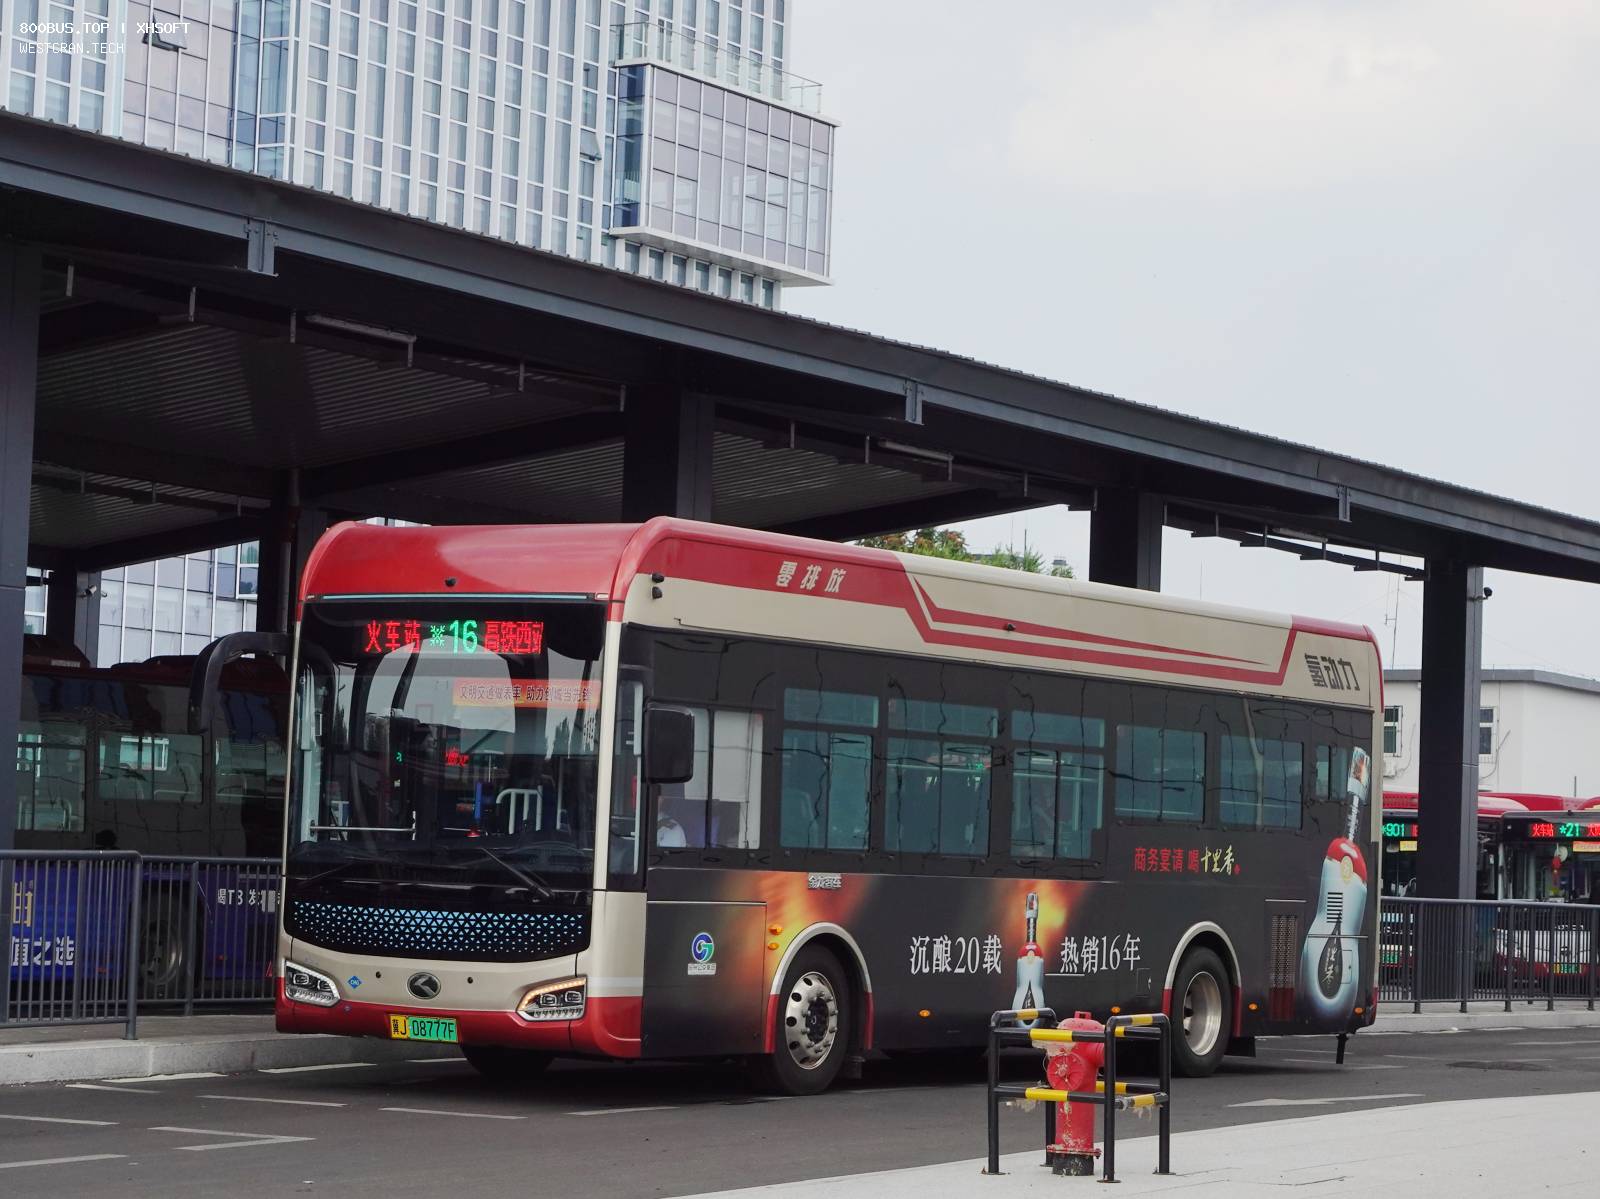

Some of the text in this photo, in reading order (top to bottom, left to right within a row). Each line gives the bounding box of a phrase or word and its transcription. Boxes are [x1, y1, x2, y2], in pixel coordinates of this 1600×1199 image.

[776, 560, 847, 593] 零排放
[364, 619, 422, 654] 火车站
[449, 619, 478, 654] 16
[1304, 653, 1361, 691] 氢动力
[1565, 822, 1580, 837] 21
[1134, 847, 1184, 873] 商务宴请
[909, 932, 1141, 975] 沉酿20载 热销16年
